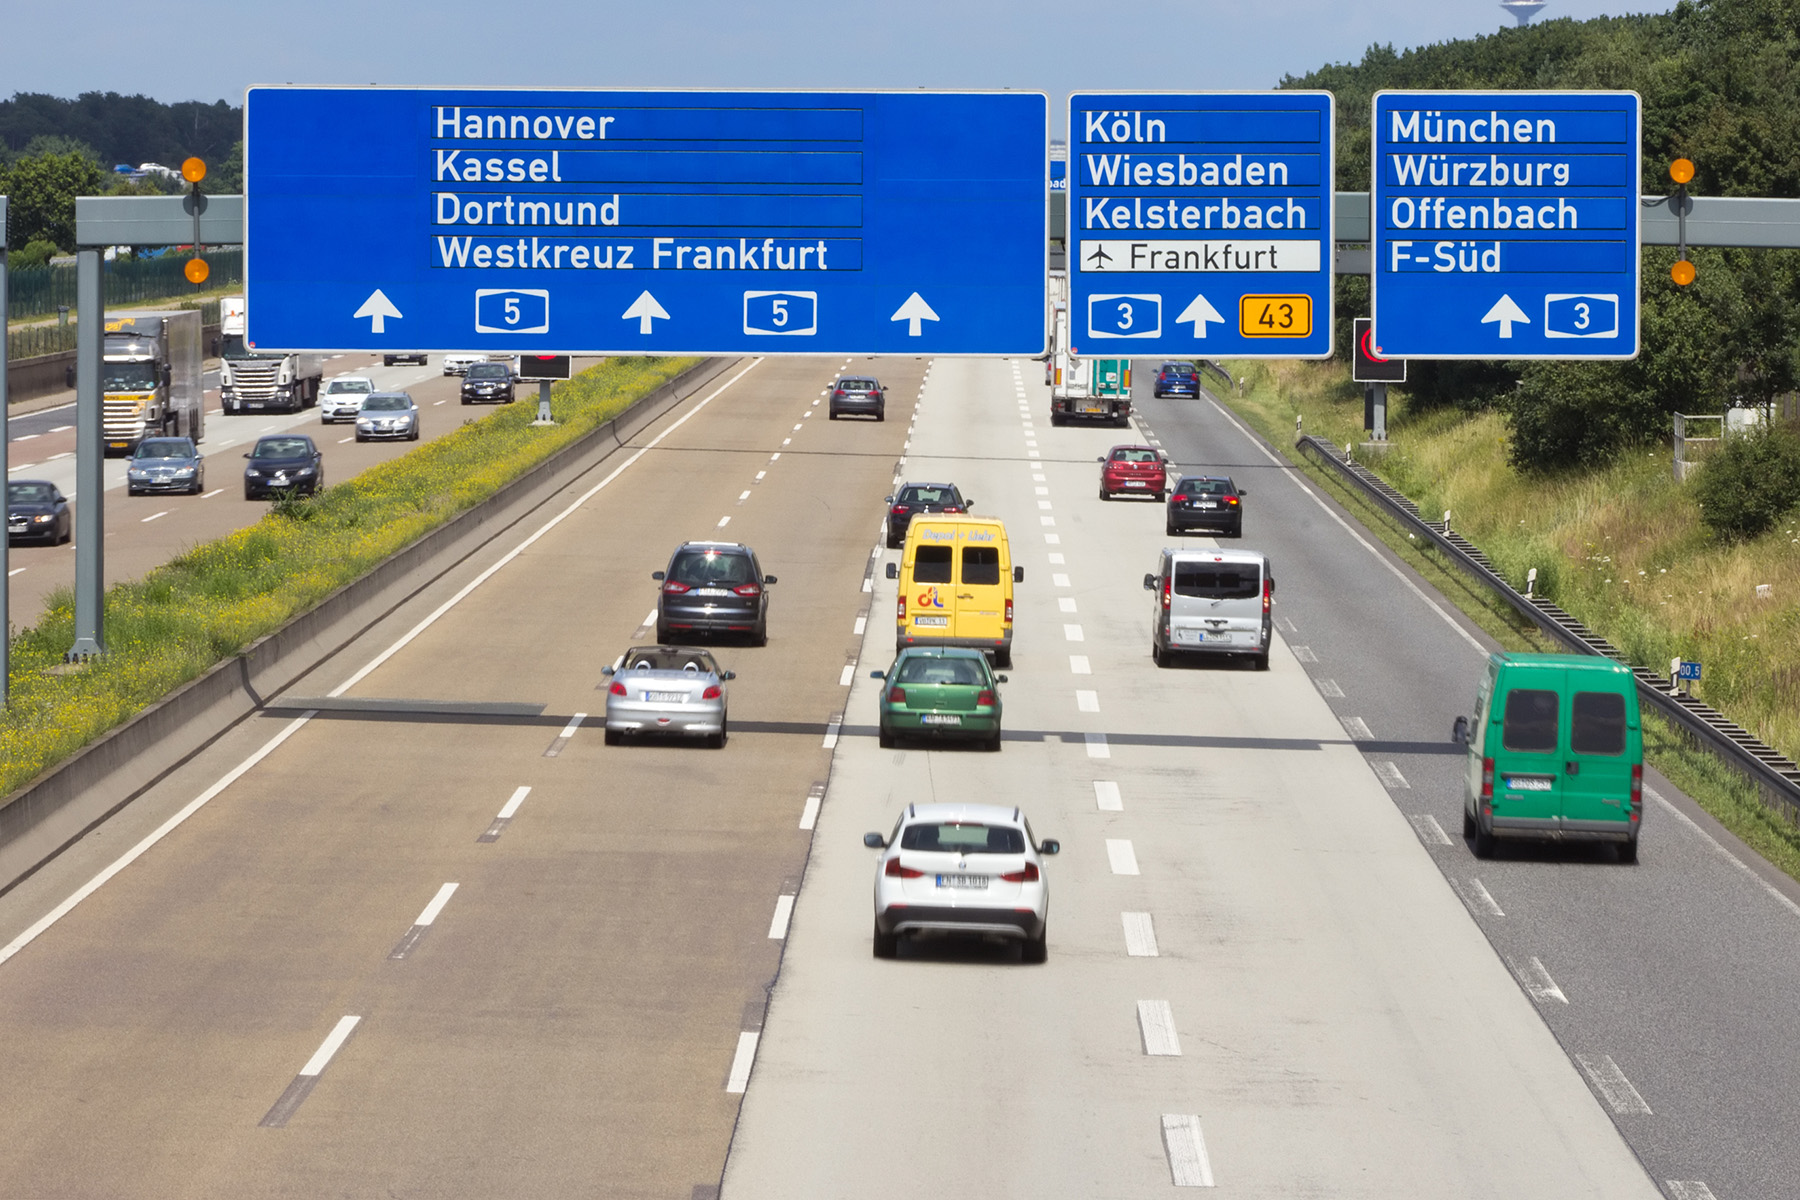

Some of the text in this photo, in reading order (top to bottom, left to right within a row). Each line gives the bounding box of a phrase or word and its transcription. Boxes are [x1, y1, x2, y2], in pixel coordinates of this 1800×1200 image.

[437, 106, 615, 139] Hannover
[1085, 110, 1166, 143] Köln
[1391, 110, 1556, 143] München
[436, 149, 562, 182] Kassel
[1087, 153, 1288, 186] Wiesbaden
[1392, 153, 1570, 187] Würzburg
[437, 192, 620, 226] Dortmund
[1085, 196, 1306, 229] Kelsterbach
[1392, 196, 1578, 229] Offenbach
[438, 235, 828, 270] Westkreuz Frankfurt
[1130, 243, 1279, 270] Frankfurt
[1391, 240, 1501, 273] F-Süd
[504, 297, 520, 325] 5
[772, 299, 788, 327] 5
[1117, 302, 1133, 330] 3
[1258, 303, 1293, 329] 43
[1574, 302, 1590, 330] 3
